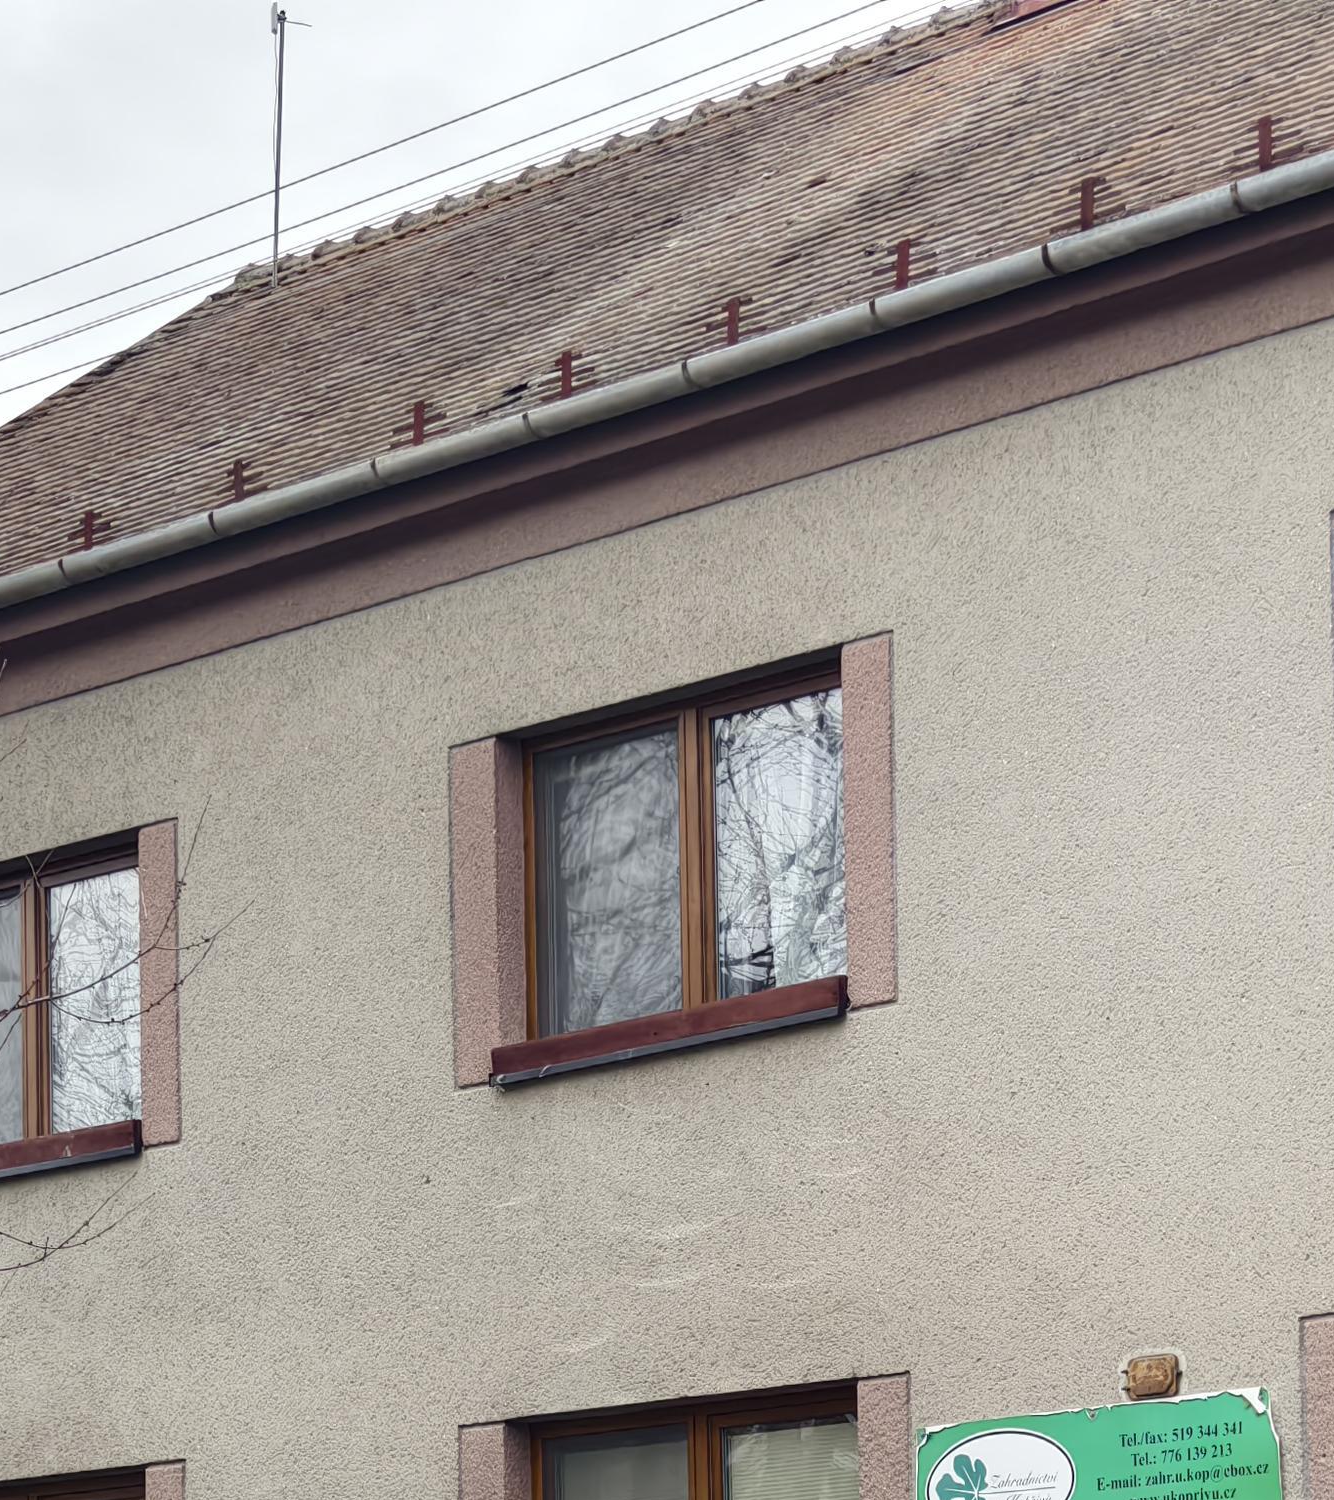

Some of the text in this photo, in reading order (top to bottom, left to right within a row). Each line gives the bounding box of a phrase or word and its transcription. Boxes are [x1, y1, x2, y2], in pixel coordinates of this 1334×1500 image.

[1119, 1421, 1243, 1448] Tel./fax: 519 344 341
[1131, 1443, 1232, 1467] Tel.: 776 139 213
[1097, 1475, 1141, 1491] E-mail:
